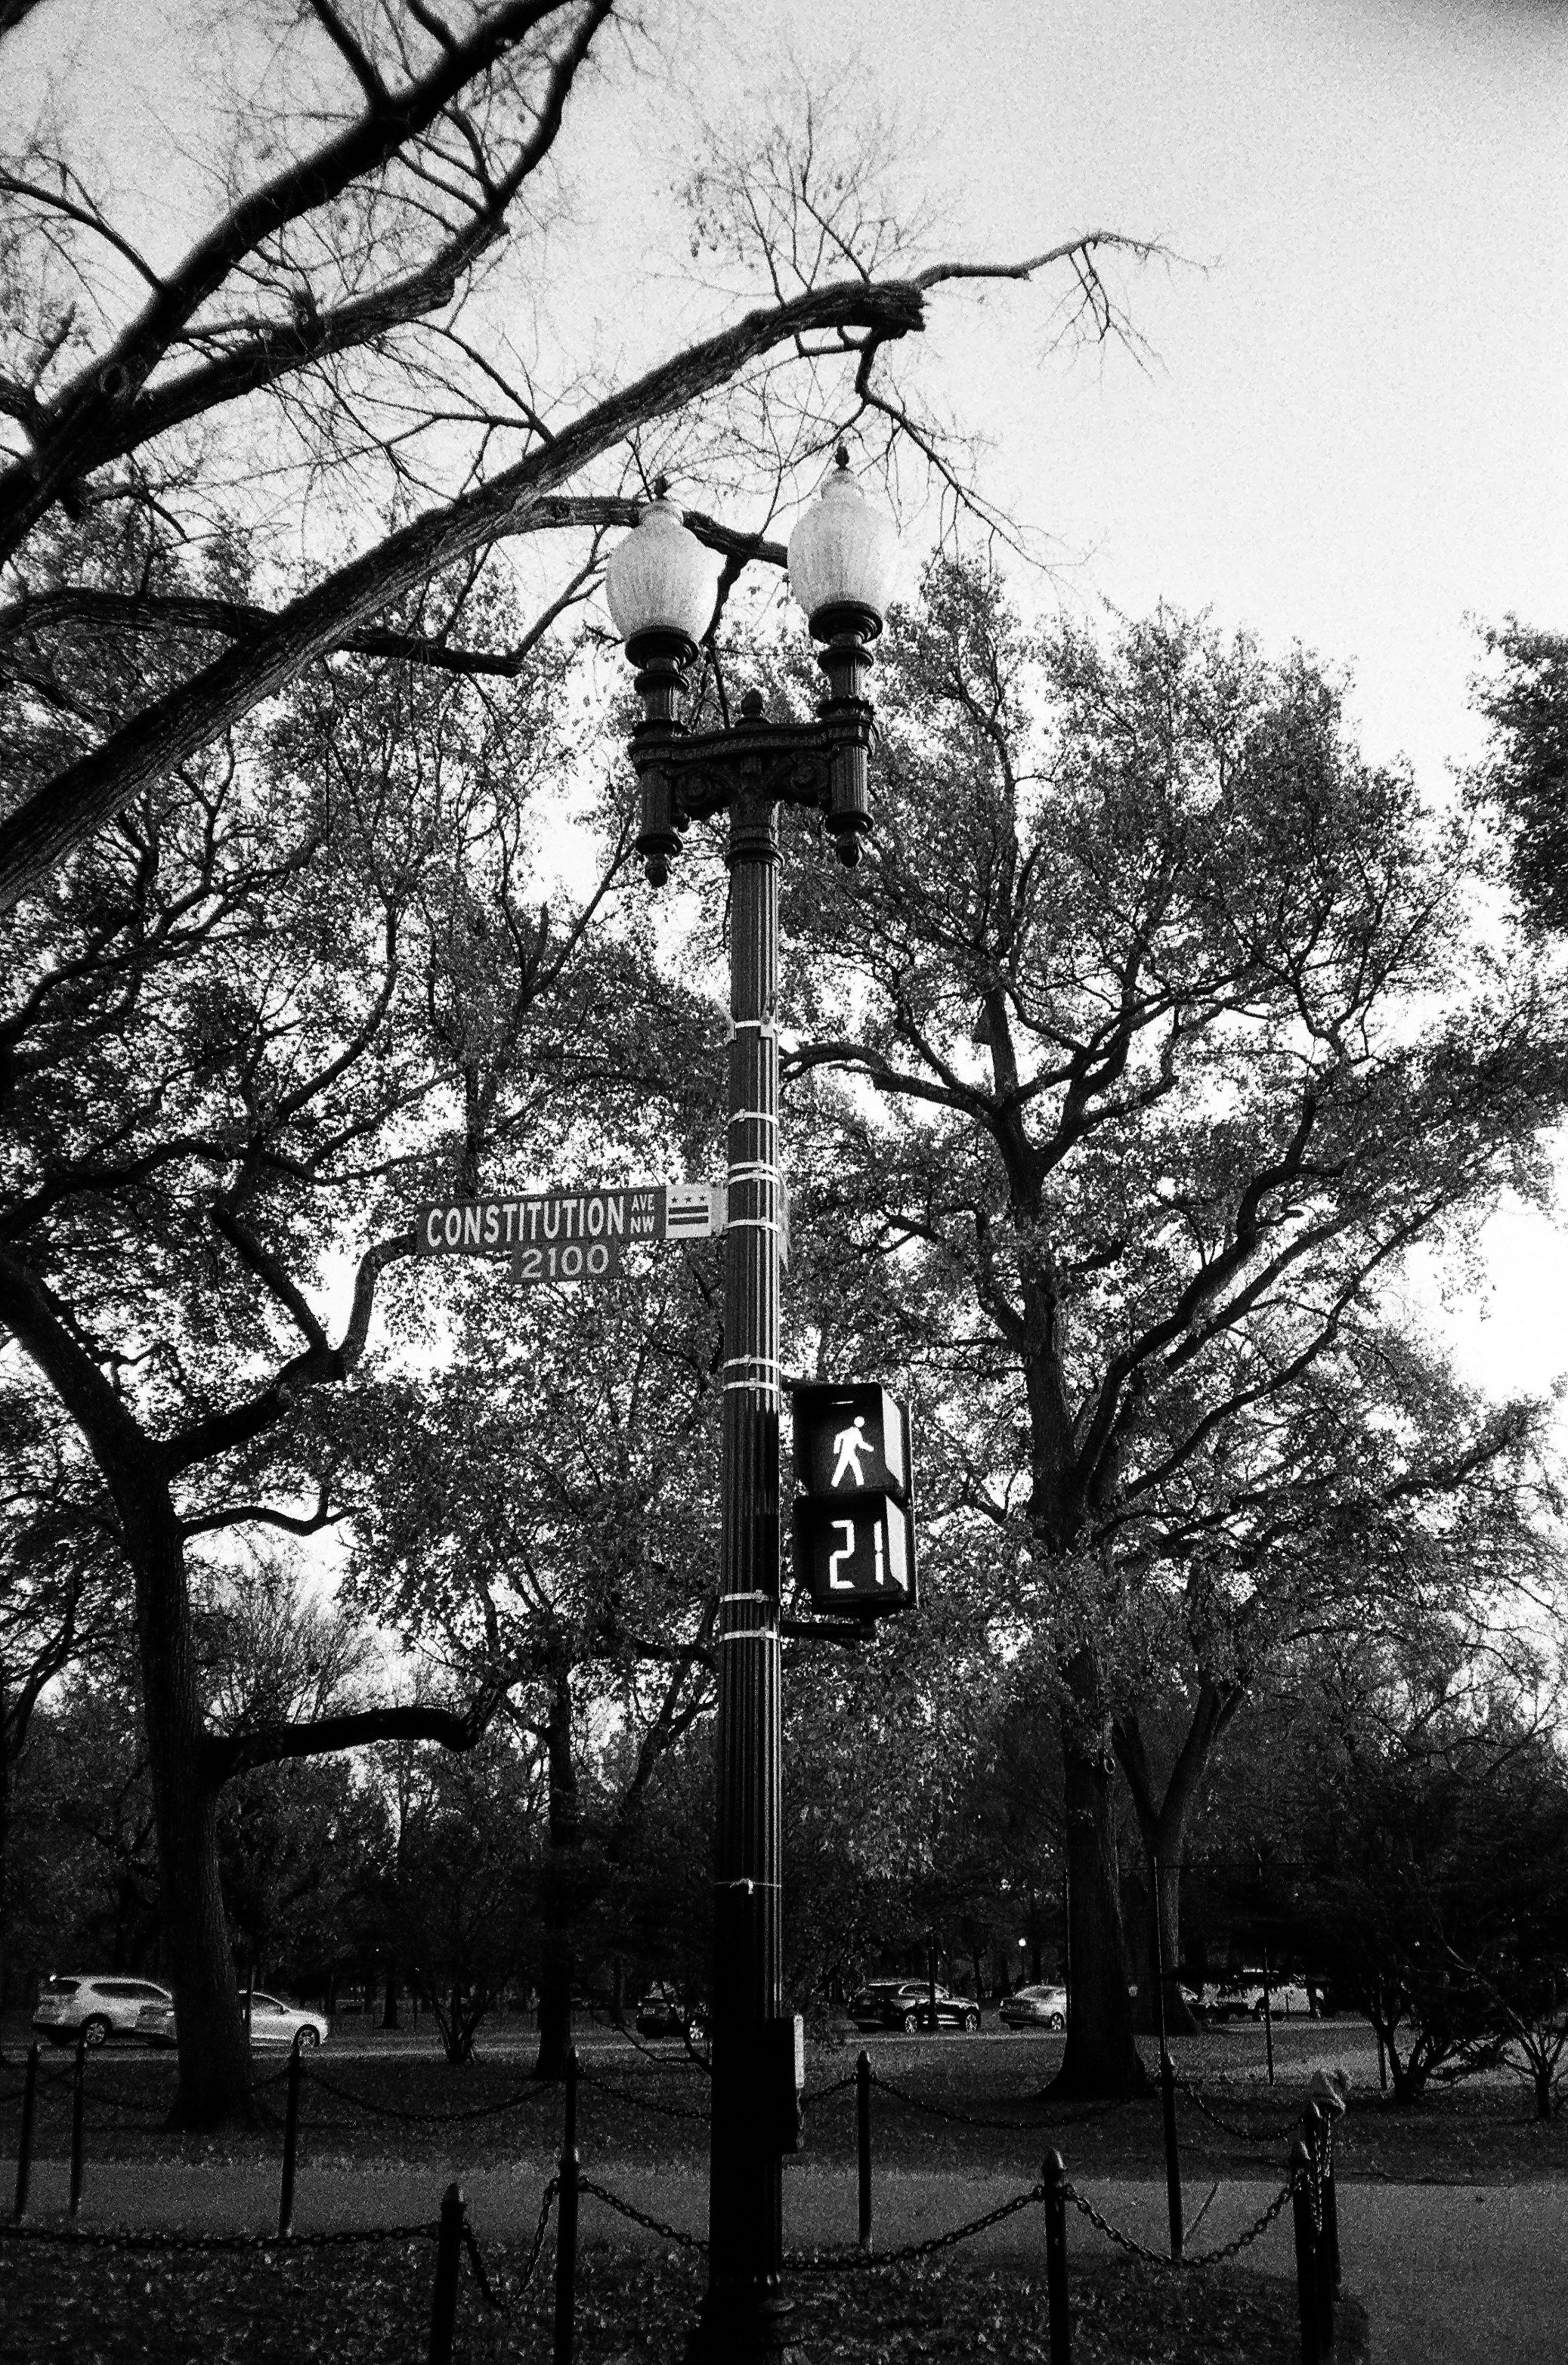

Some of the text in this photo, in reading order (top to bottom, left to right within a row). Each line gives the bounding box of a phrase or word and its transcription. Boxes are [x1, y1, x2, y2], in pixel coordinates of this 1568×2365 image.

[427, 1194, 655, 1247] CONSTITUTION AVE
[631, 1216, 655, 1234] NW
[521, 1244, 608, 1279] 2100
[830, 1519, 884, 1589] 21
